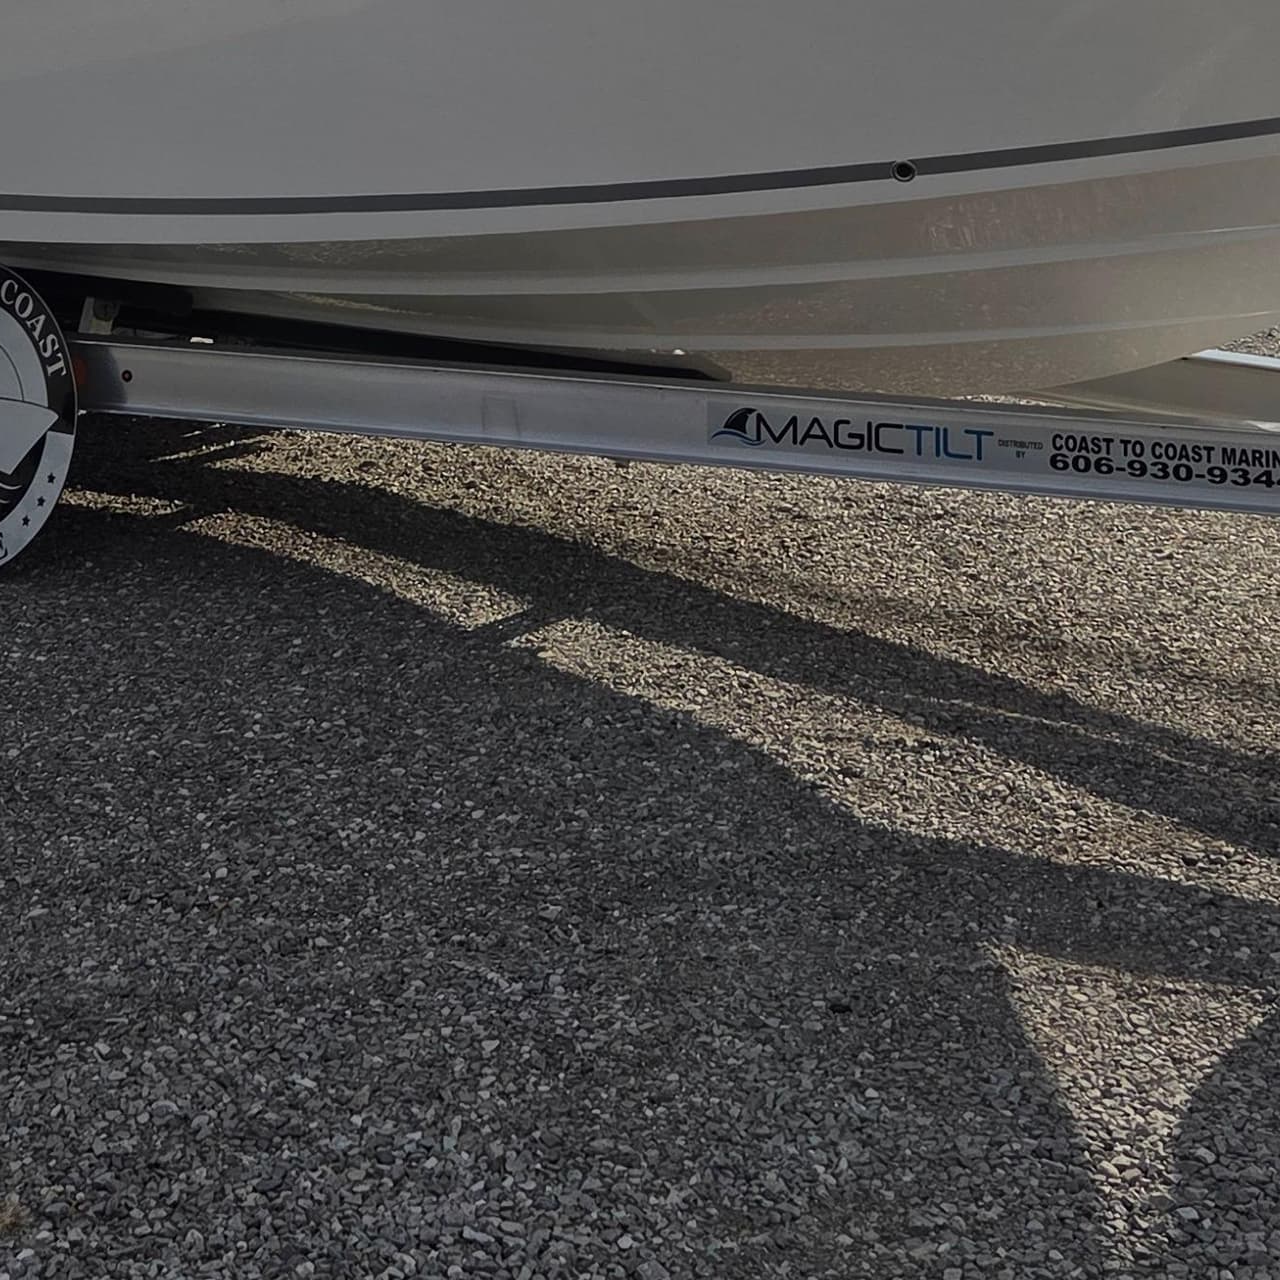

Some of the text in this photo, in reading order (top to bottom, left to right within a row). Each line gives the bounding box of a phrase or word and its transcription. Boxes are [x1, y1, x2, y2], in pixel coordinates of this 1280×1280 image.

[0, 279, 67, 377] COAST
[754, 412, 995, 461] MAGICTILT
[1051, 433, 1114, 456] COAST
[1120, 438, 1145, 458] TO
[1150, 441, 1215, 464] COAST
